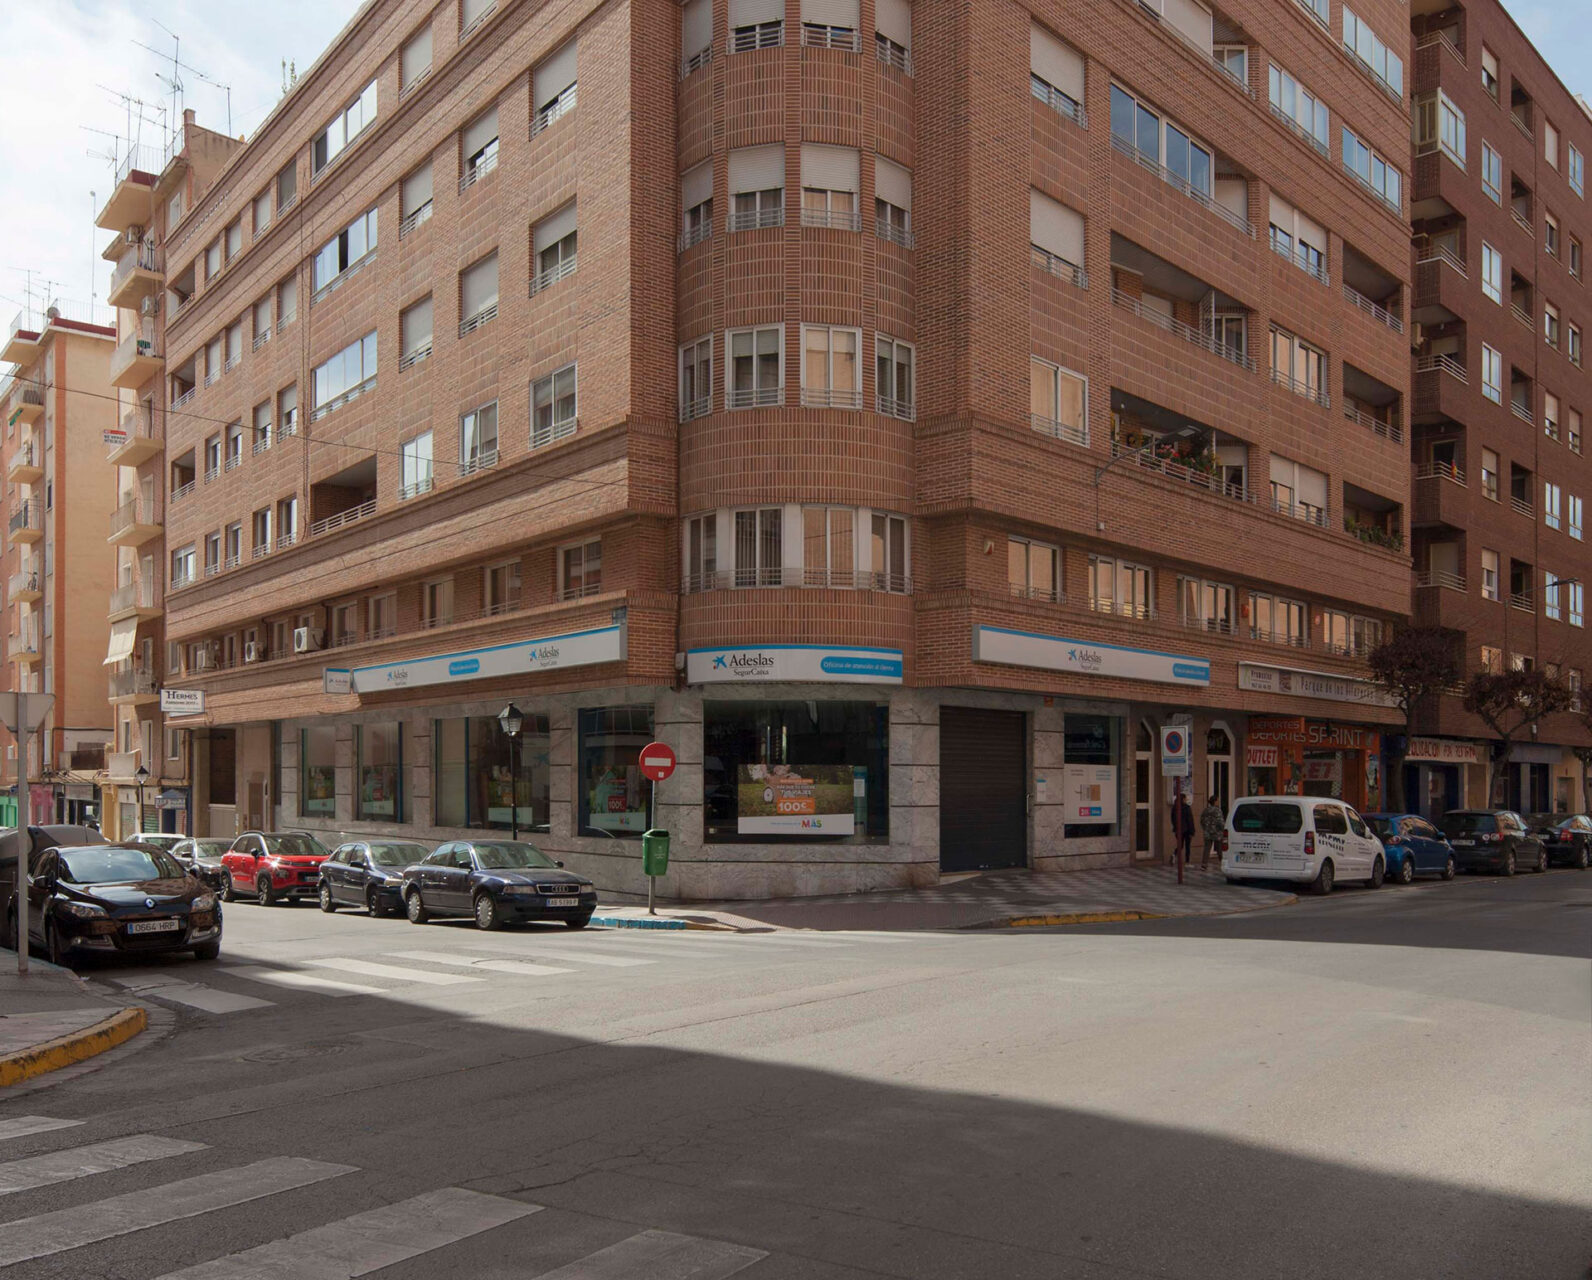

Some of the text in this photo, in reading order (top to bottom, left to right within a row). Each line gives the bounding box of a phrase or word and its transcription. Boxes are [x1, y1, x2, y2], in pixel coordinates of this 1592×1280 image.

[538, 646, 560, 659] Adeslas
[1078, 650, 1102, 663] Adeslas
[729, 653, 774, 666] Adeslas
[733, 668, 769, 677] SegurCaixa
[165, 691, 198, 700] HERMES
[1253, 720, 1299, 730] DEPORTES
[1252, 726, 1363, 746] DEPORTES SPRINT
[1247, 749, 1278, 766] OUTLET
